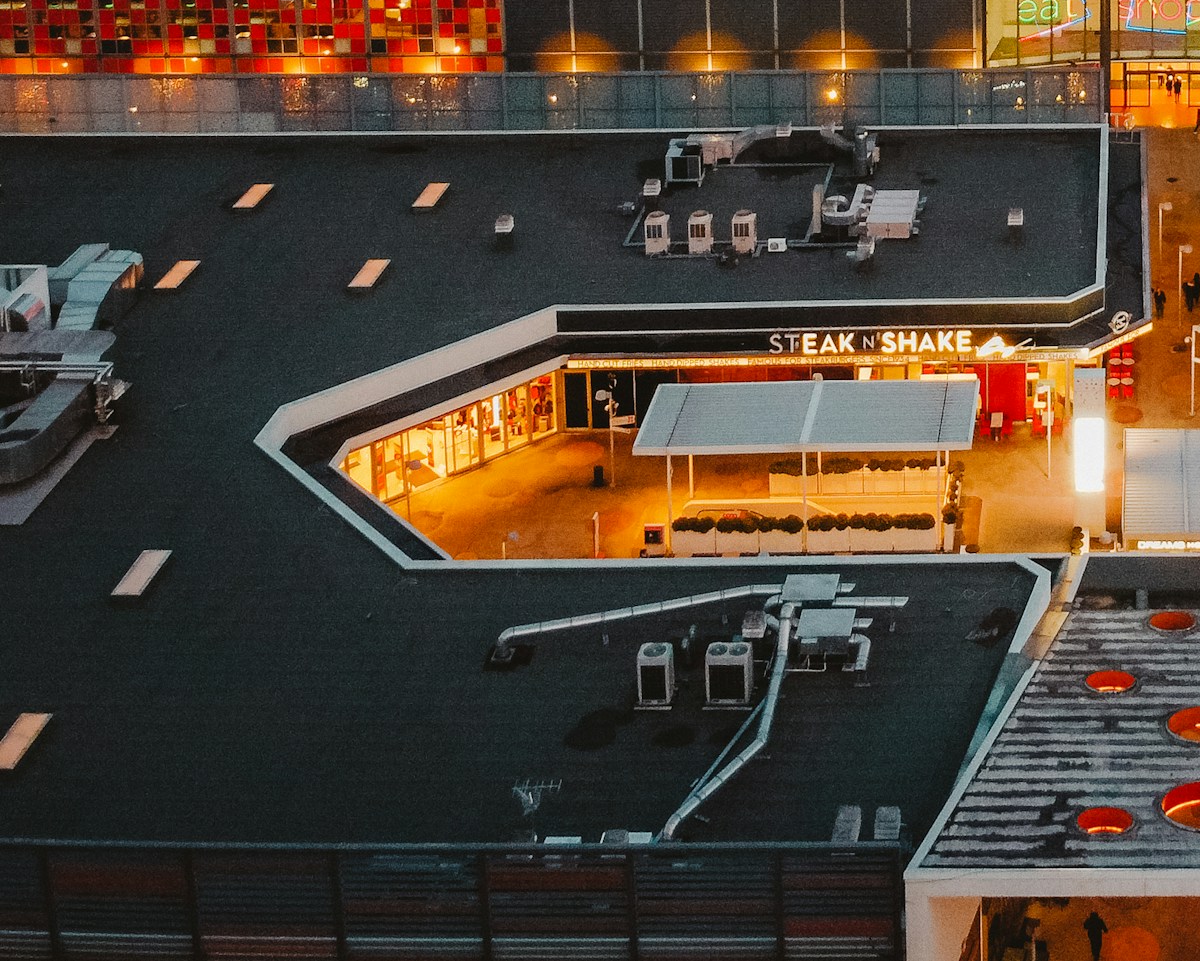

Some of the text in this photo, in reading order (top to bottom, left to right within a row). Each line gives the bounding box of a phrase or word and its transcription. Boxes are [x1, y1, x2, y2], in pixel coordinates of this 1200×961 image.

[769, 331, 855, 355] STEAK
[881, 330, 972, 353] SHAKE
[577, 360, 600, 368] HAND
[602, 360, 620, 368] CUT
